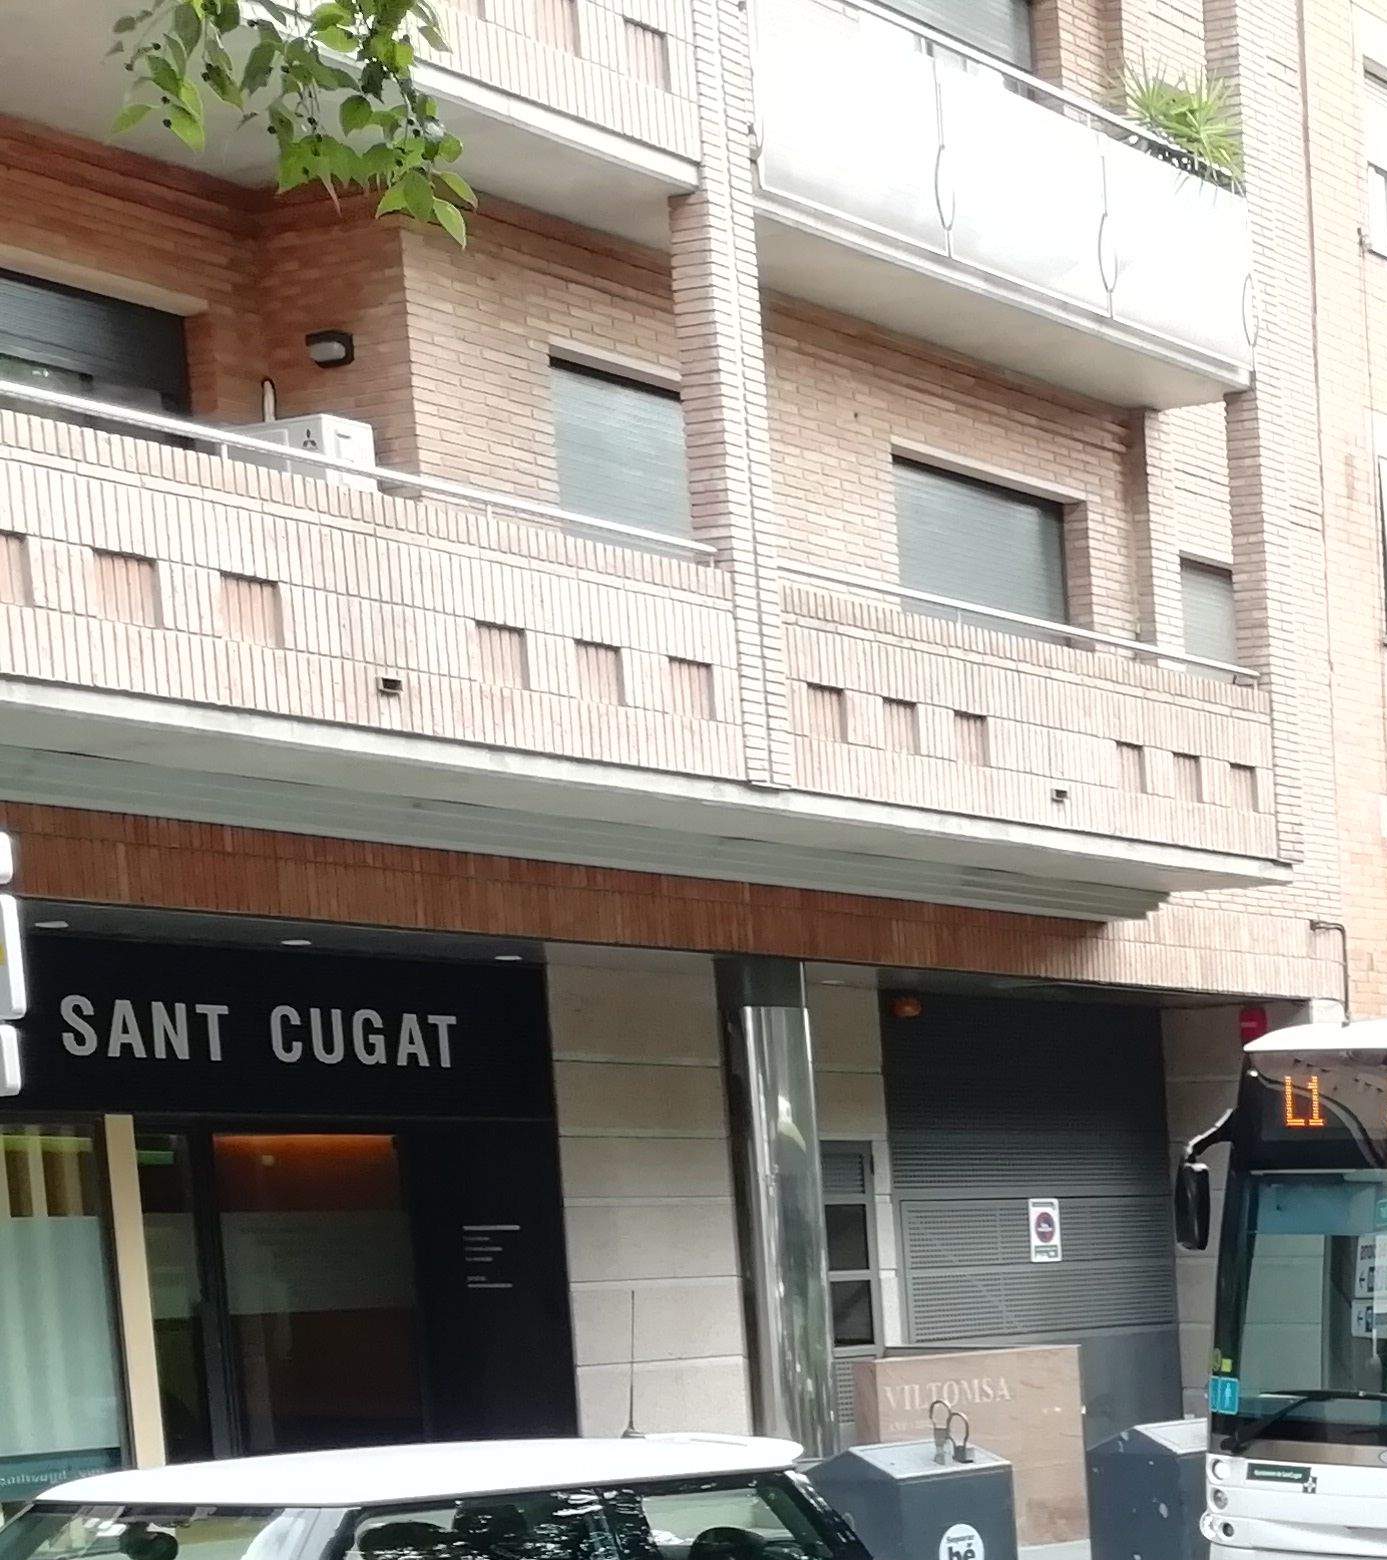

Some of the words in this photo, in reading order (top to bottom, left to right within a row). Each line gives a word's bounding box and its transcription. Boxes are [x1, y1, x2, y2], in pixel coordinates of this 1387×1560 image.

[60, 994, 229, 1062] SANT
[269, 1004, 457, 1069] CUGAT
[1283, 1075, 1325, 1127] L1
